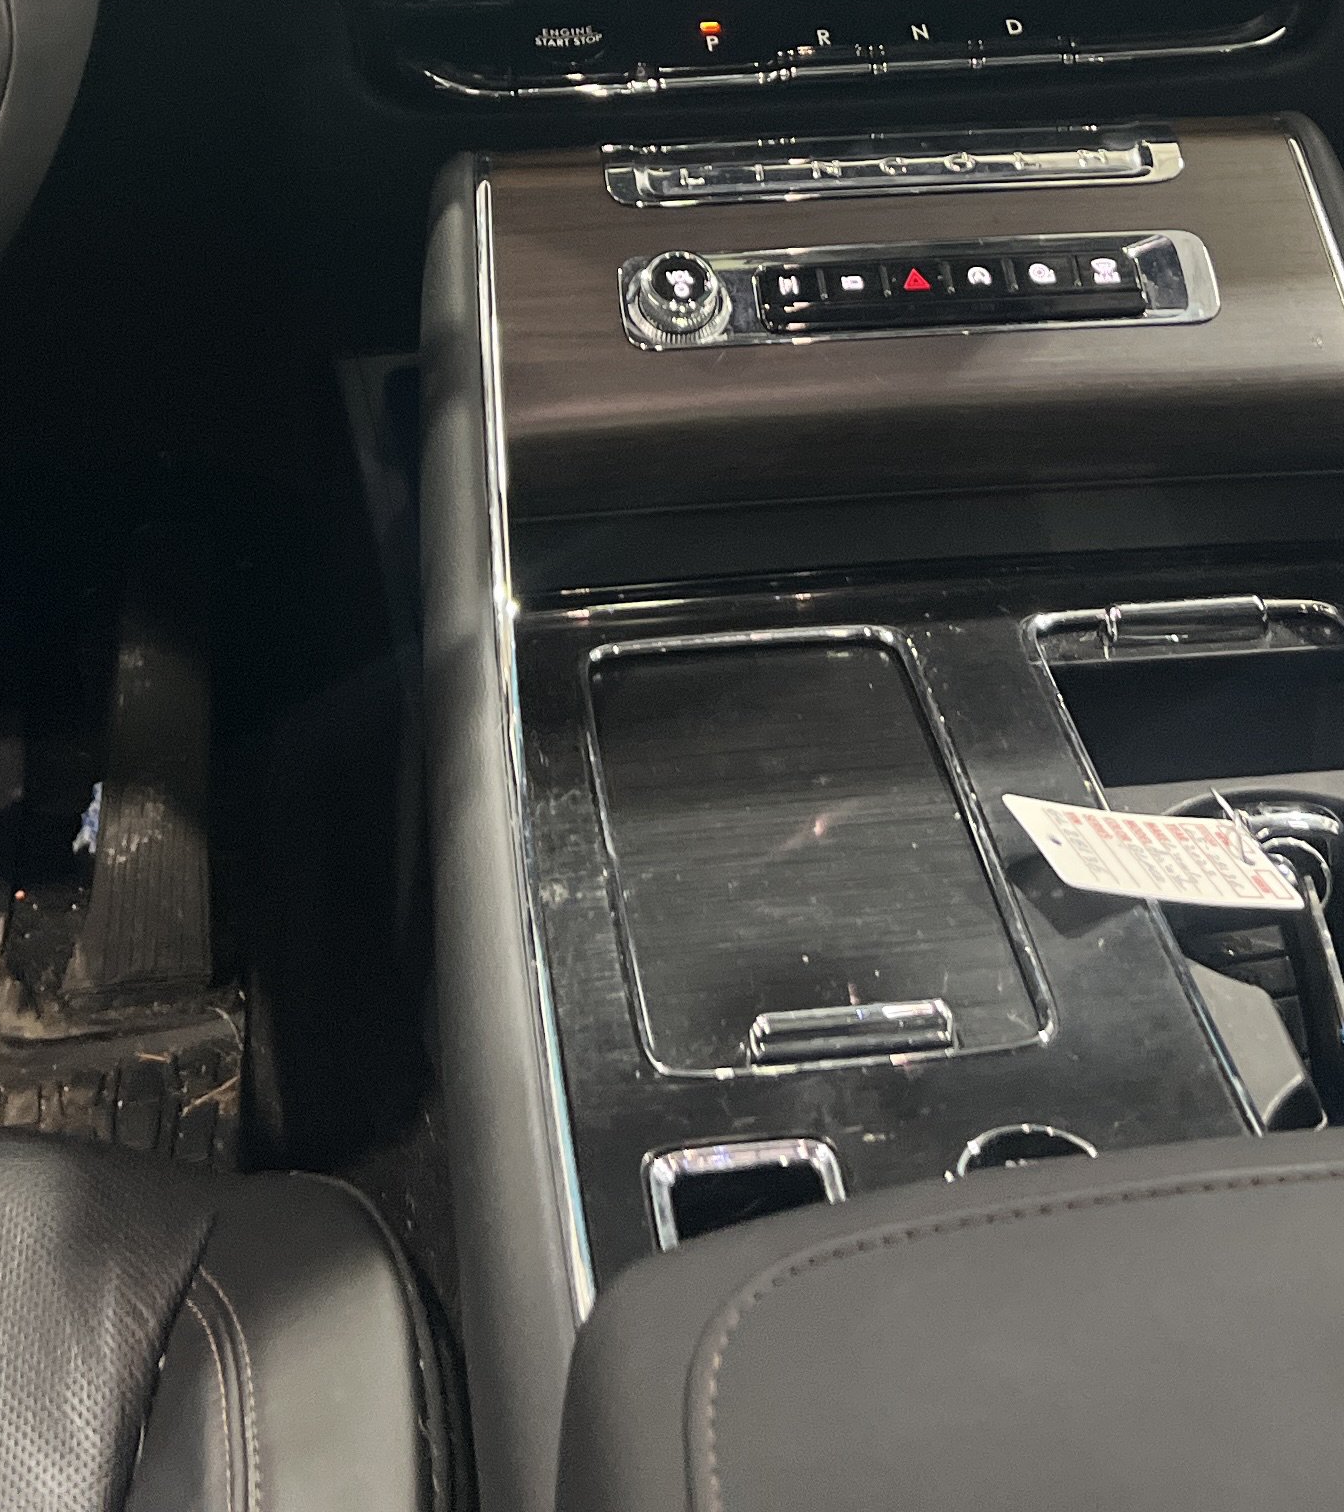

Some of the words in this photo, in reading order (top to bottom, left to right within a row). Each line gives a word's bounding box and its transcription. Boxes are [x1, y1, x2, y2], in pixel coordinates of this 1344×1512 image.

[534, 36, 570, 47] START
[573, 33, 603, 46] STOP
[542, 25, 593, 38] ENGINE
[705, 35, 719, 52] P
[816, 29, 831, 46] R
[911, 23, 929, 41] N
[1005, 18, 1023, 36] D
[679, 148, 1108, 187] LINCOLN
